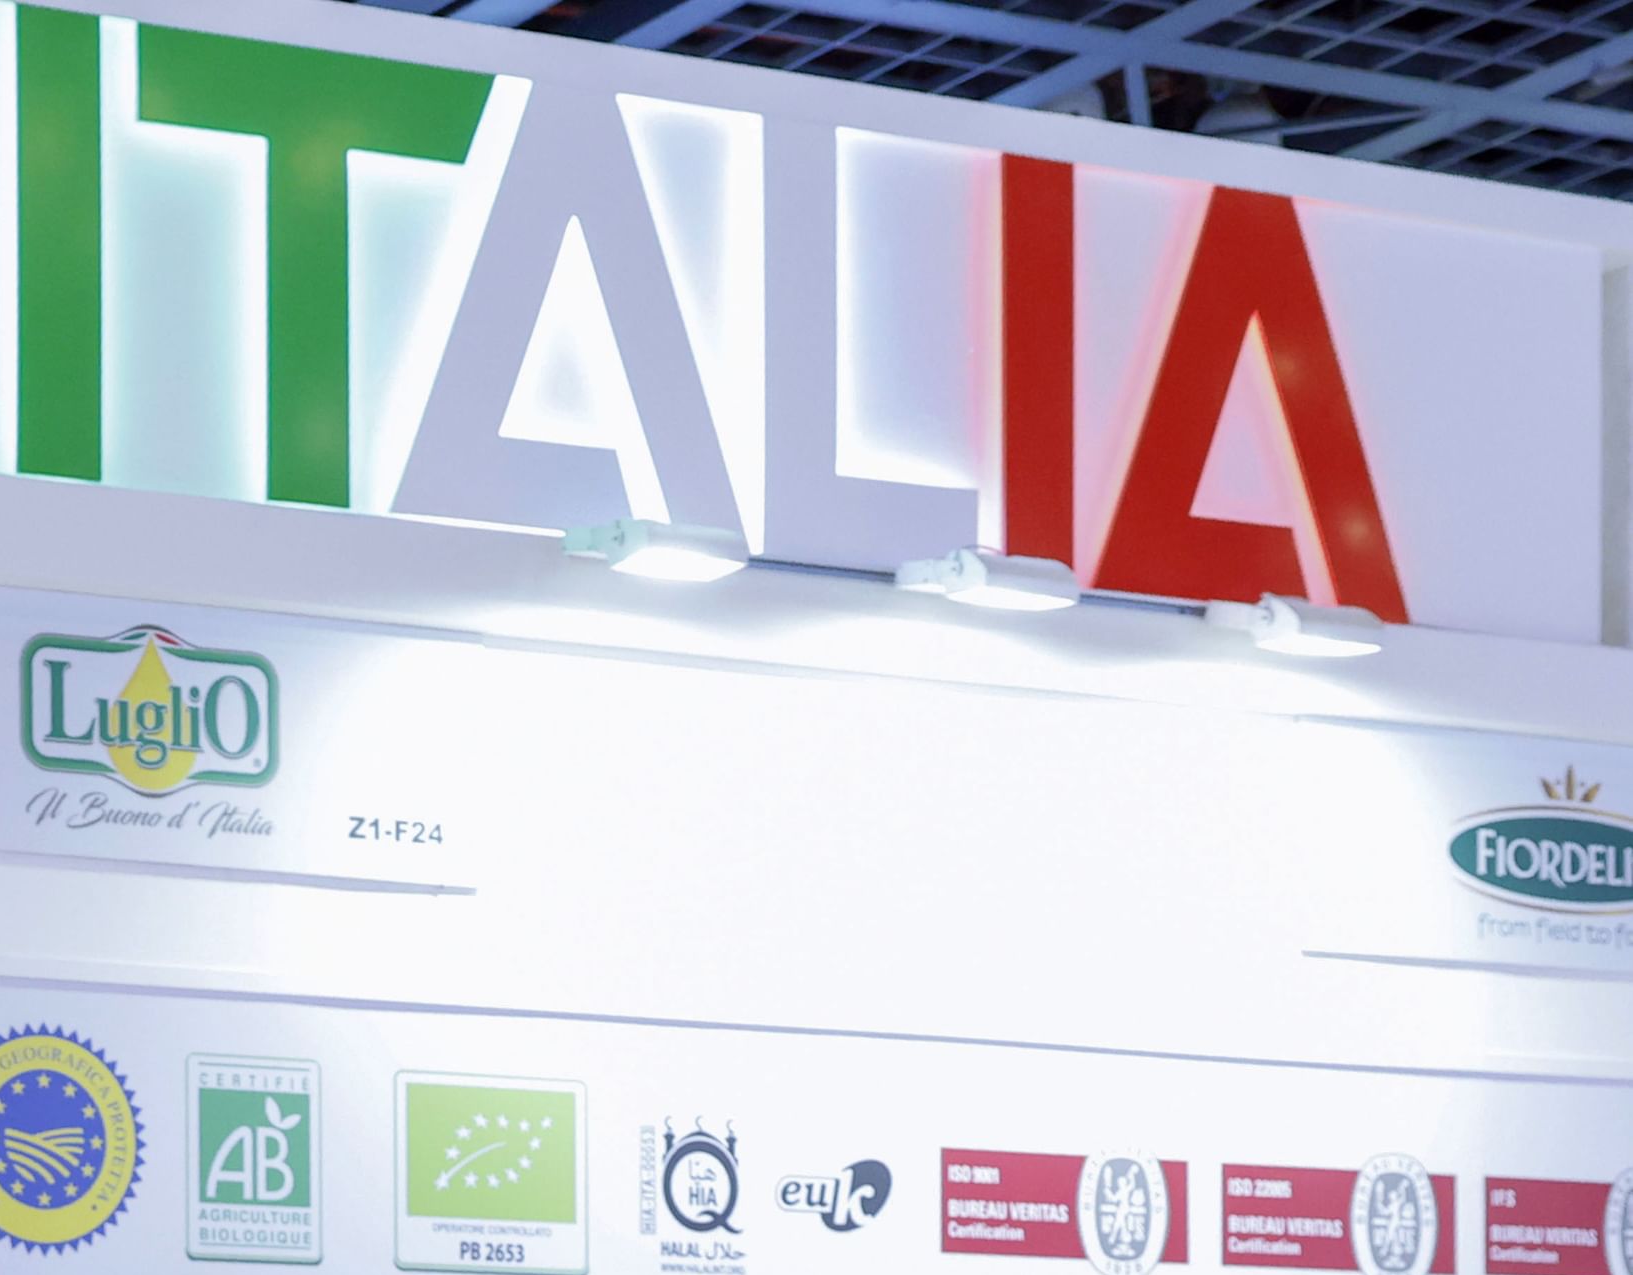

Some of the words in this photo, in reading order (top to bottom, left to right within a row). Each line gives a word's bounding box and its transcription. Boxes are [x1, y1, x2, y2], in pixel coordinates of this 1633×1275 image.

[14, 8, 1412, 626] ITALIA
[42, 658, 262, 771] LugliO
[347, 815, 444, 845] Z1-F24
[206, 1126, 294, 1201] AB
[198, 1208, 312, 1226] AGRICULTURE
[947, 1198, 1007, 1219] BUREAU
[1008, 1201, 1070, 1223] VERITAS
[198, 1227, 312, 1245] BIOLOGIQUE
[459, 1241, 481, 1260] PB
[485, 1242, 525, 1262] 2653
